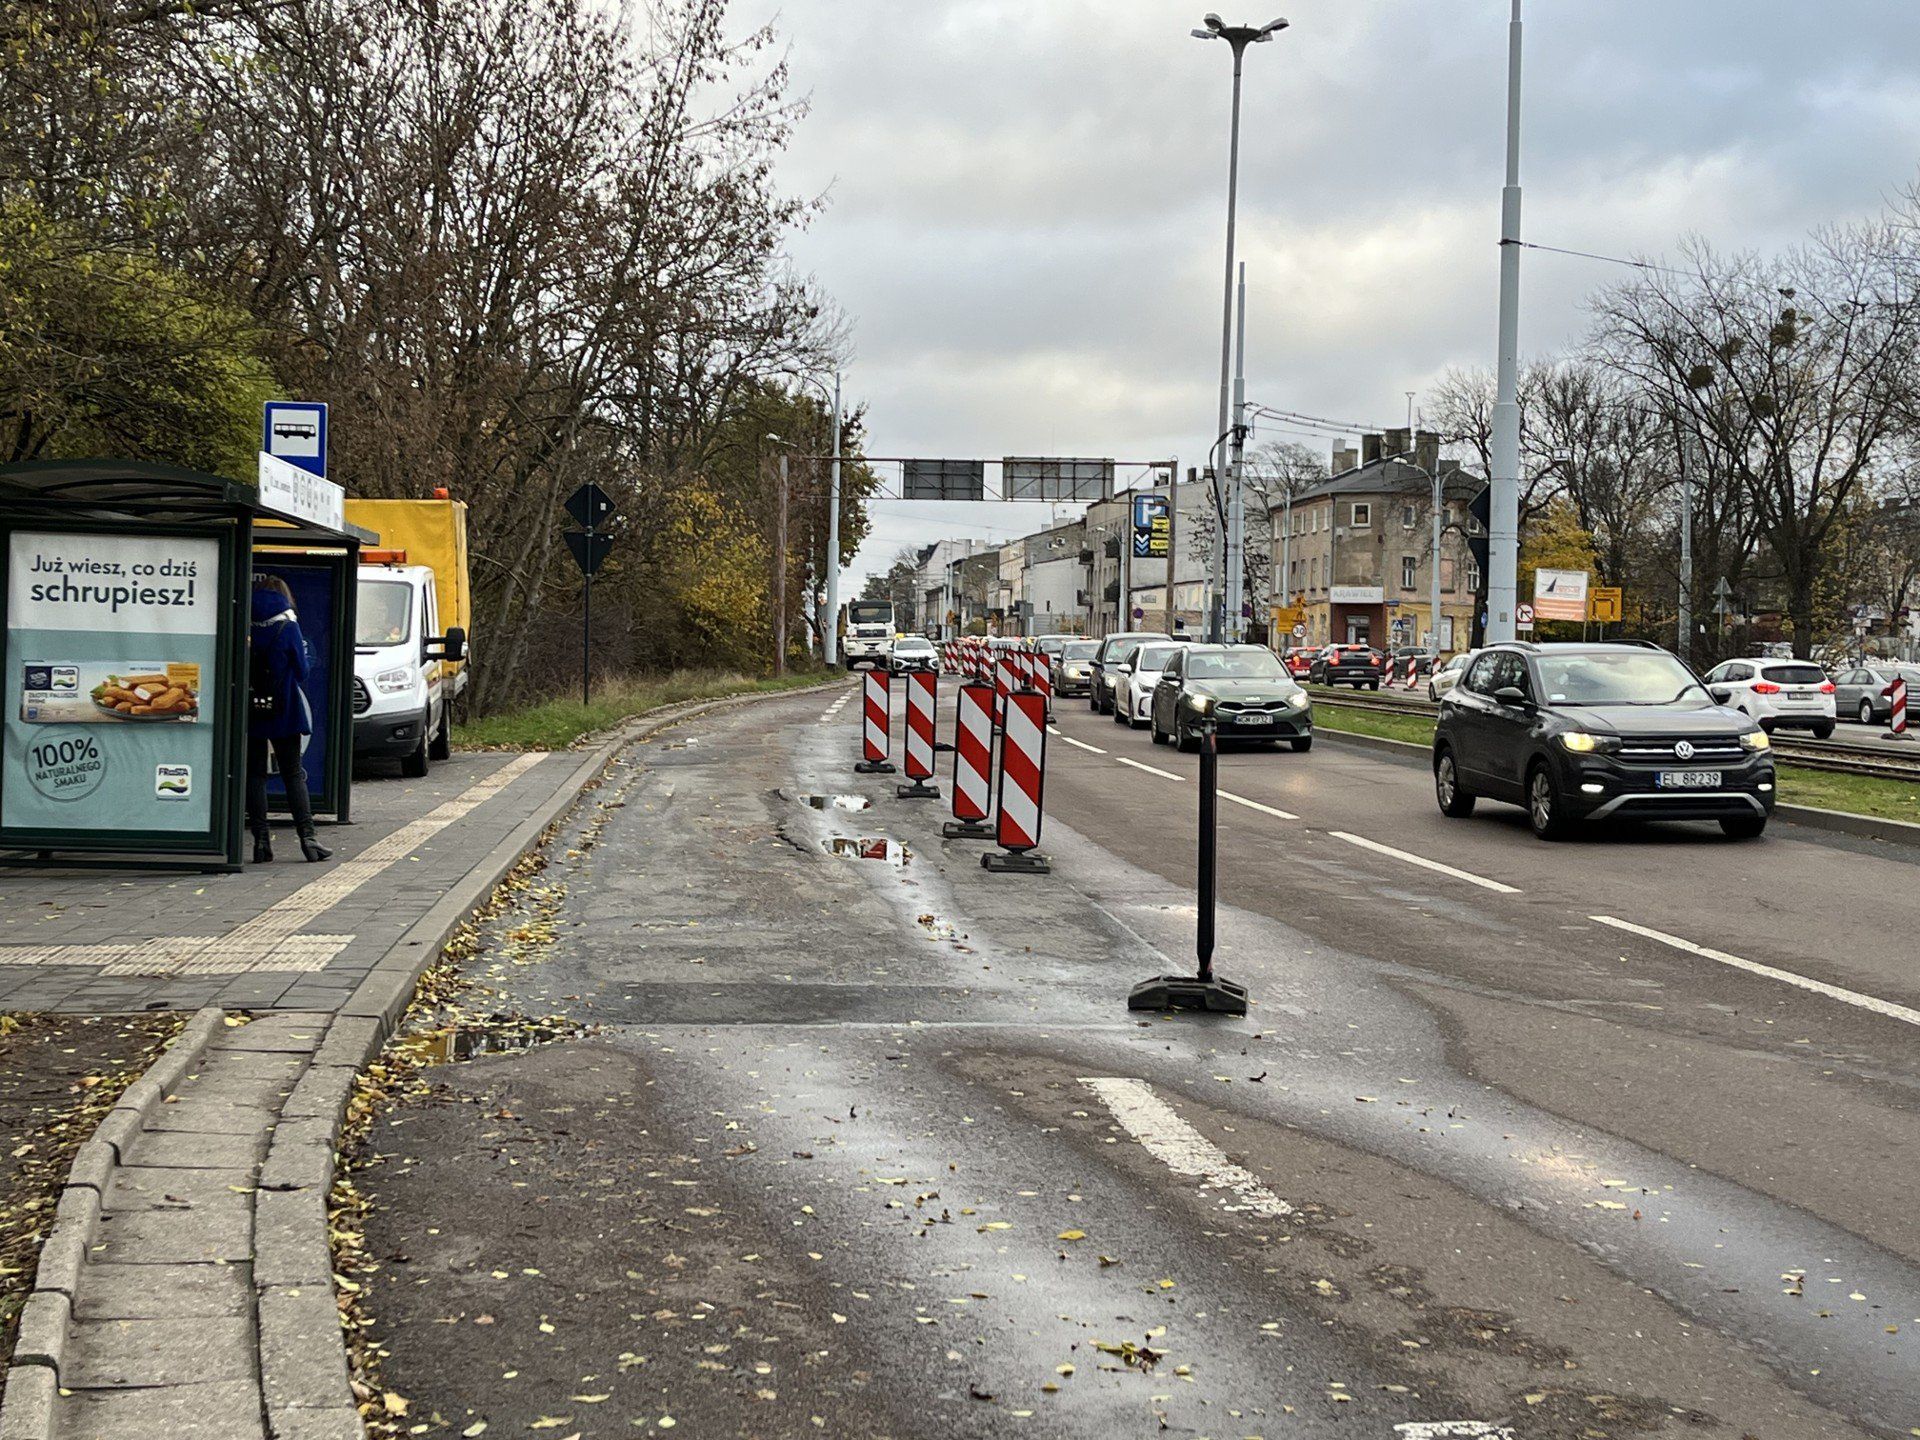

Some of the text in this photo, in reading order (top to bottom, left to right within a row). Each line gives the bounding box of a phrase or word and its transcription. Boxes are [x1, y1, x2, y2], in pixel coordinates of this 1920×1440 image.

[31, 555, 197, 577] Już wiesz, co dziś
[31, 574, 195, 613] schrupiesz!
[32, 737, 99, 768] 100%
[35, 760, 101, 781] NATURALNEGO
[1663, 773, 1719, 786] EL 8R239
[54, 776, 87, 788] SMAKU
